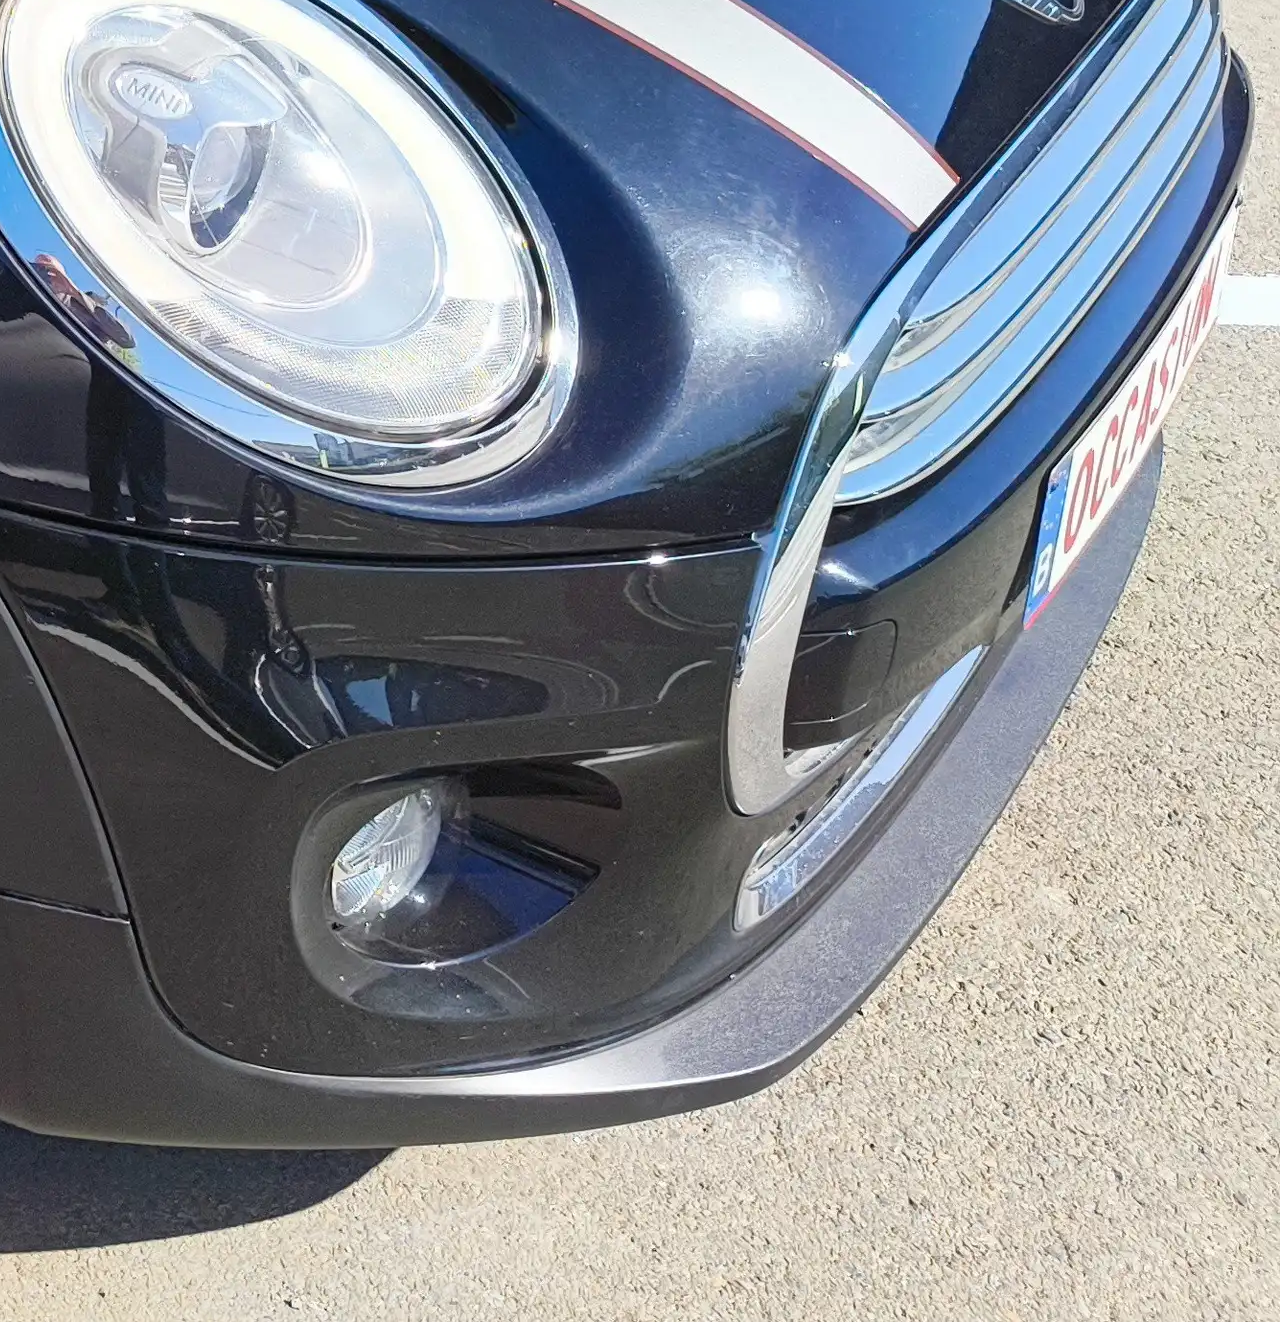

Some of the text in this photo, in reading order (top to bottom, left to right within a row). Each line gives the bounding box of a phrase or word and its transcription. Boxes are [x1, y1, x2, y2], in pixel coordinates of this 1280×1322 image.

[127, 77, 185, 115] MINI
[1062, 240, 1224, 555] OCCASION
[1032, 541, 1054, 596] B
